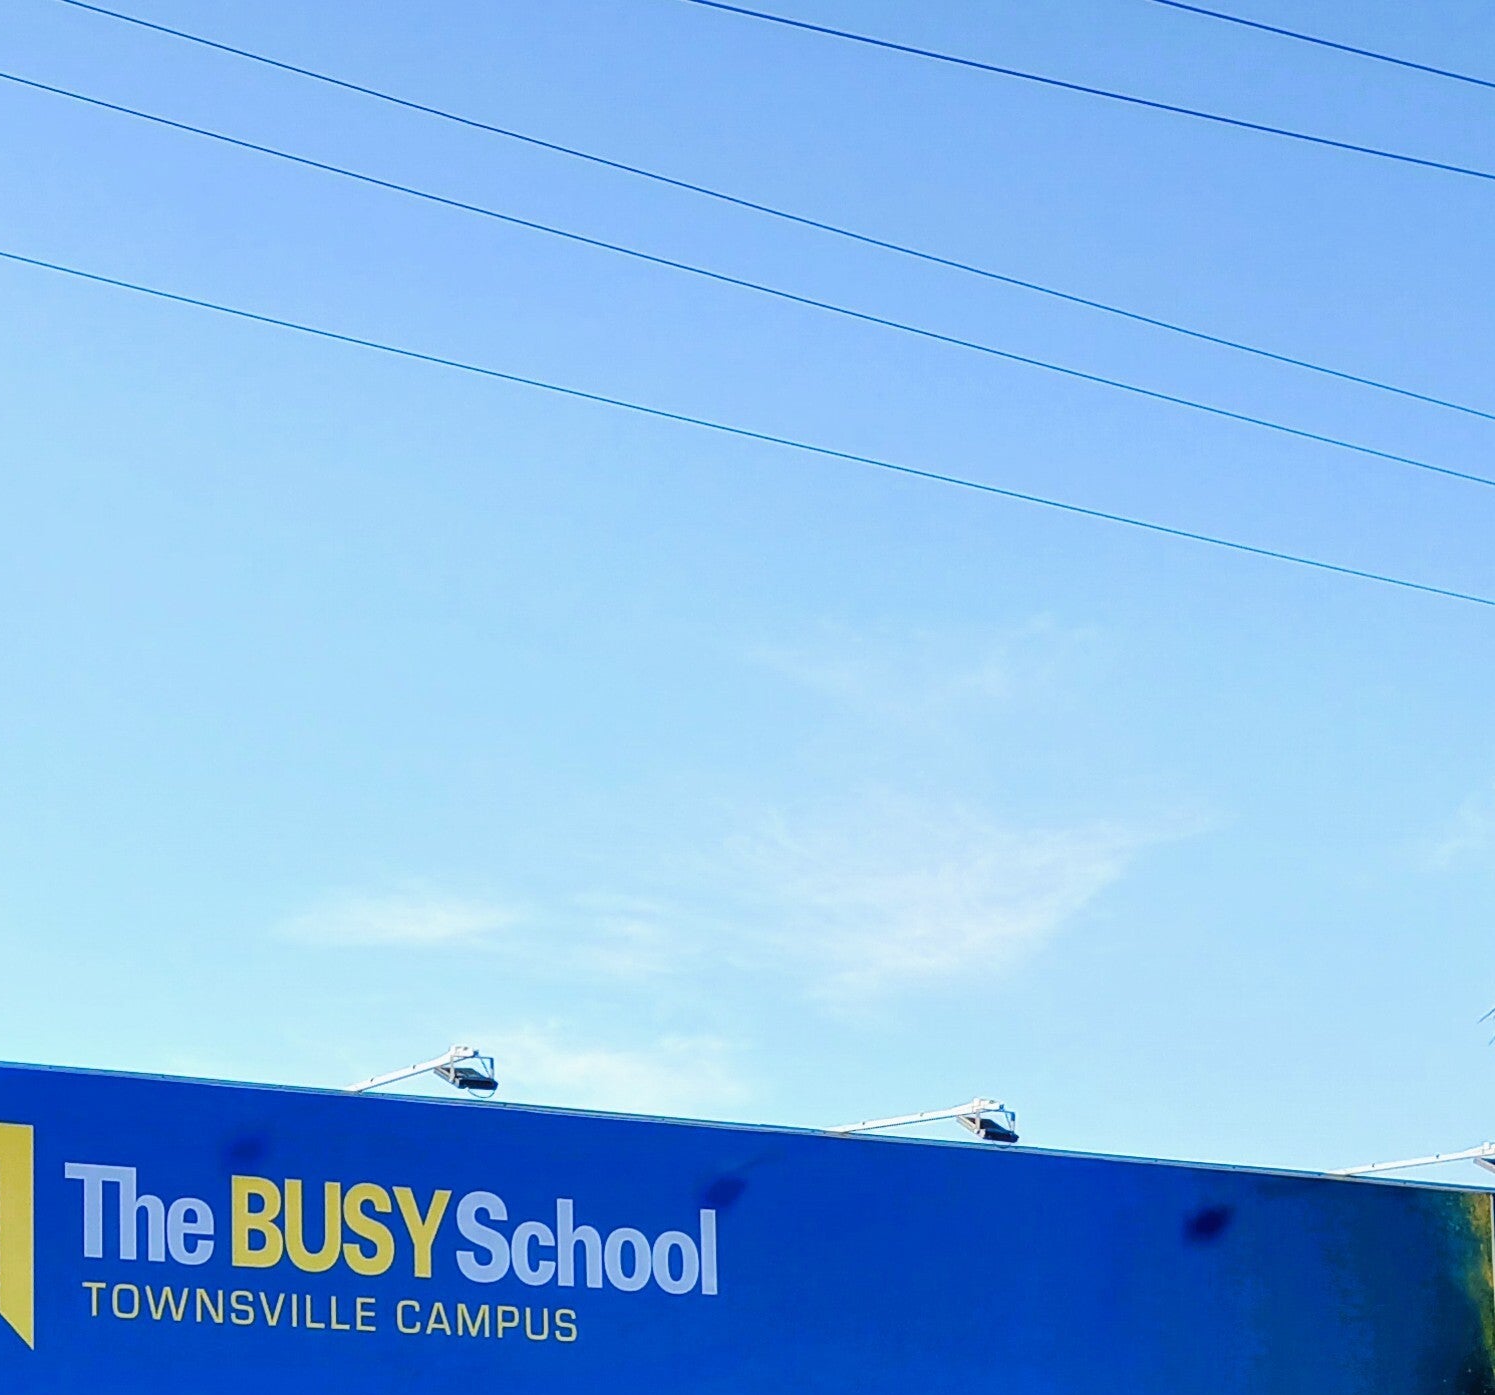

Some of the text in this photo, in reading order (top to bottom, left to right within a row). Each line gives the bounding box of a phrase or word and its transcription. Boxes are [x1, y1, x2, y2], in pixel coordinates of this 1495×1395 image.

[65, 1162, 718, 1295] The BUSY School
[82, 1281, 577, 1342] TOWNSVILLE CAMPUS
